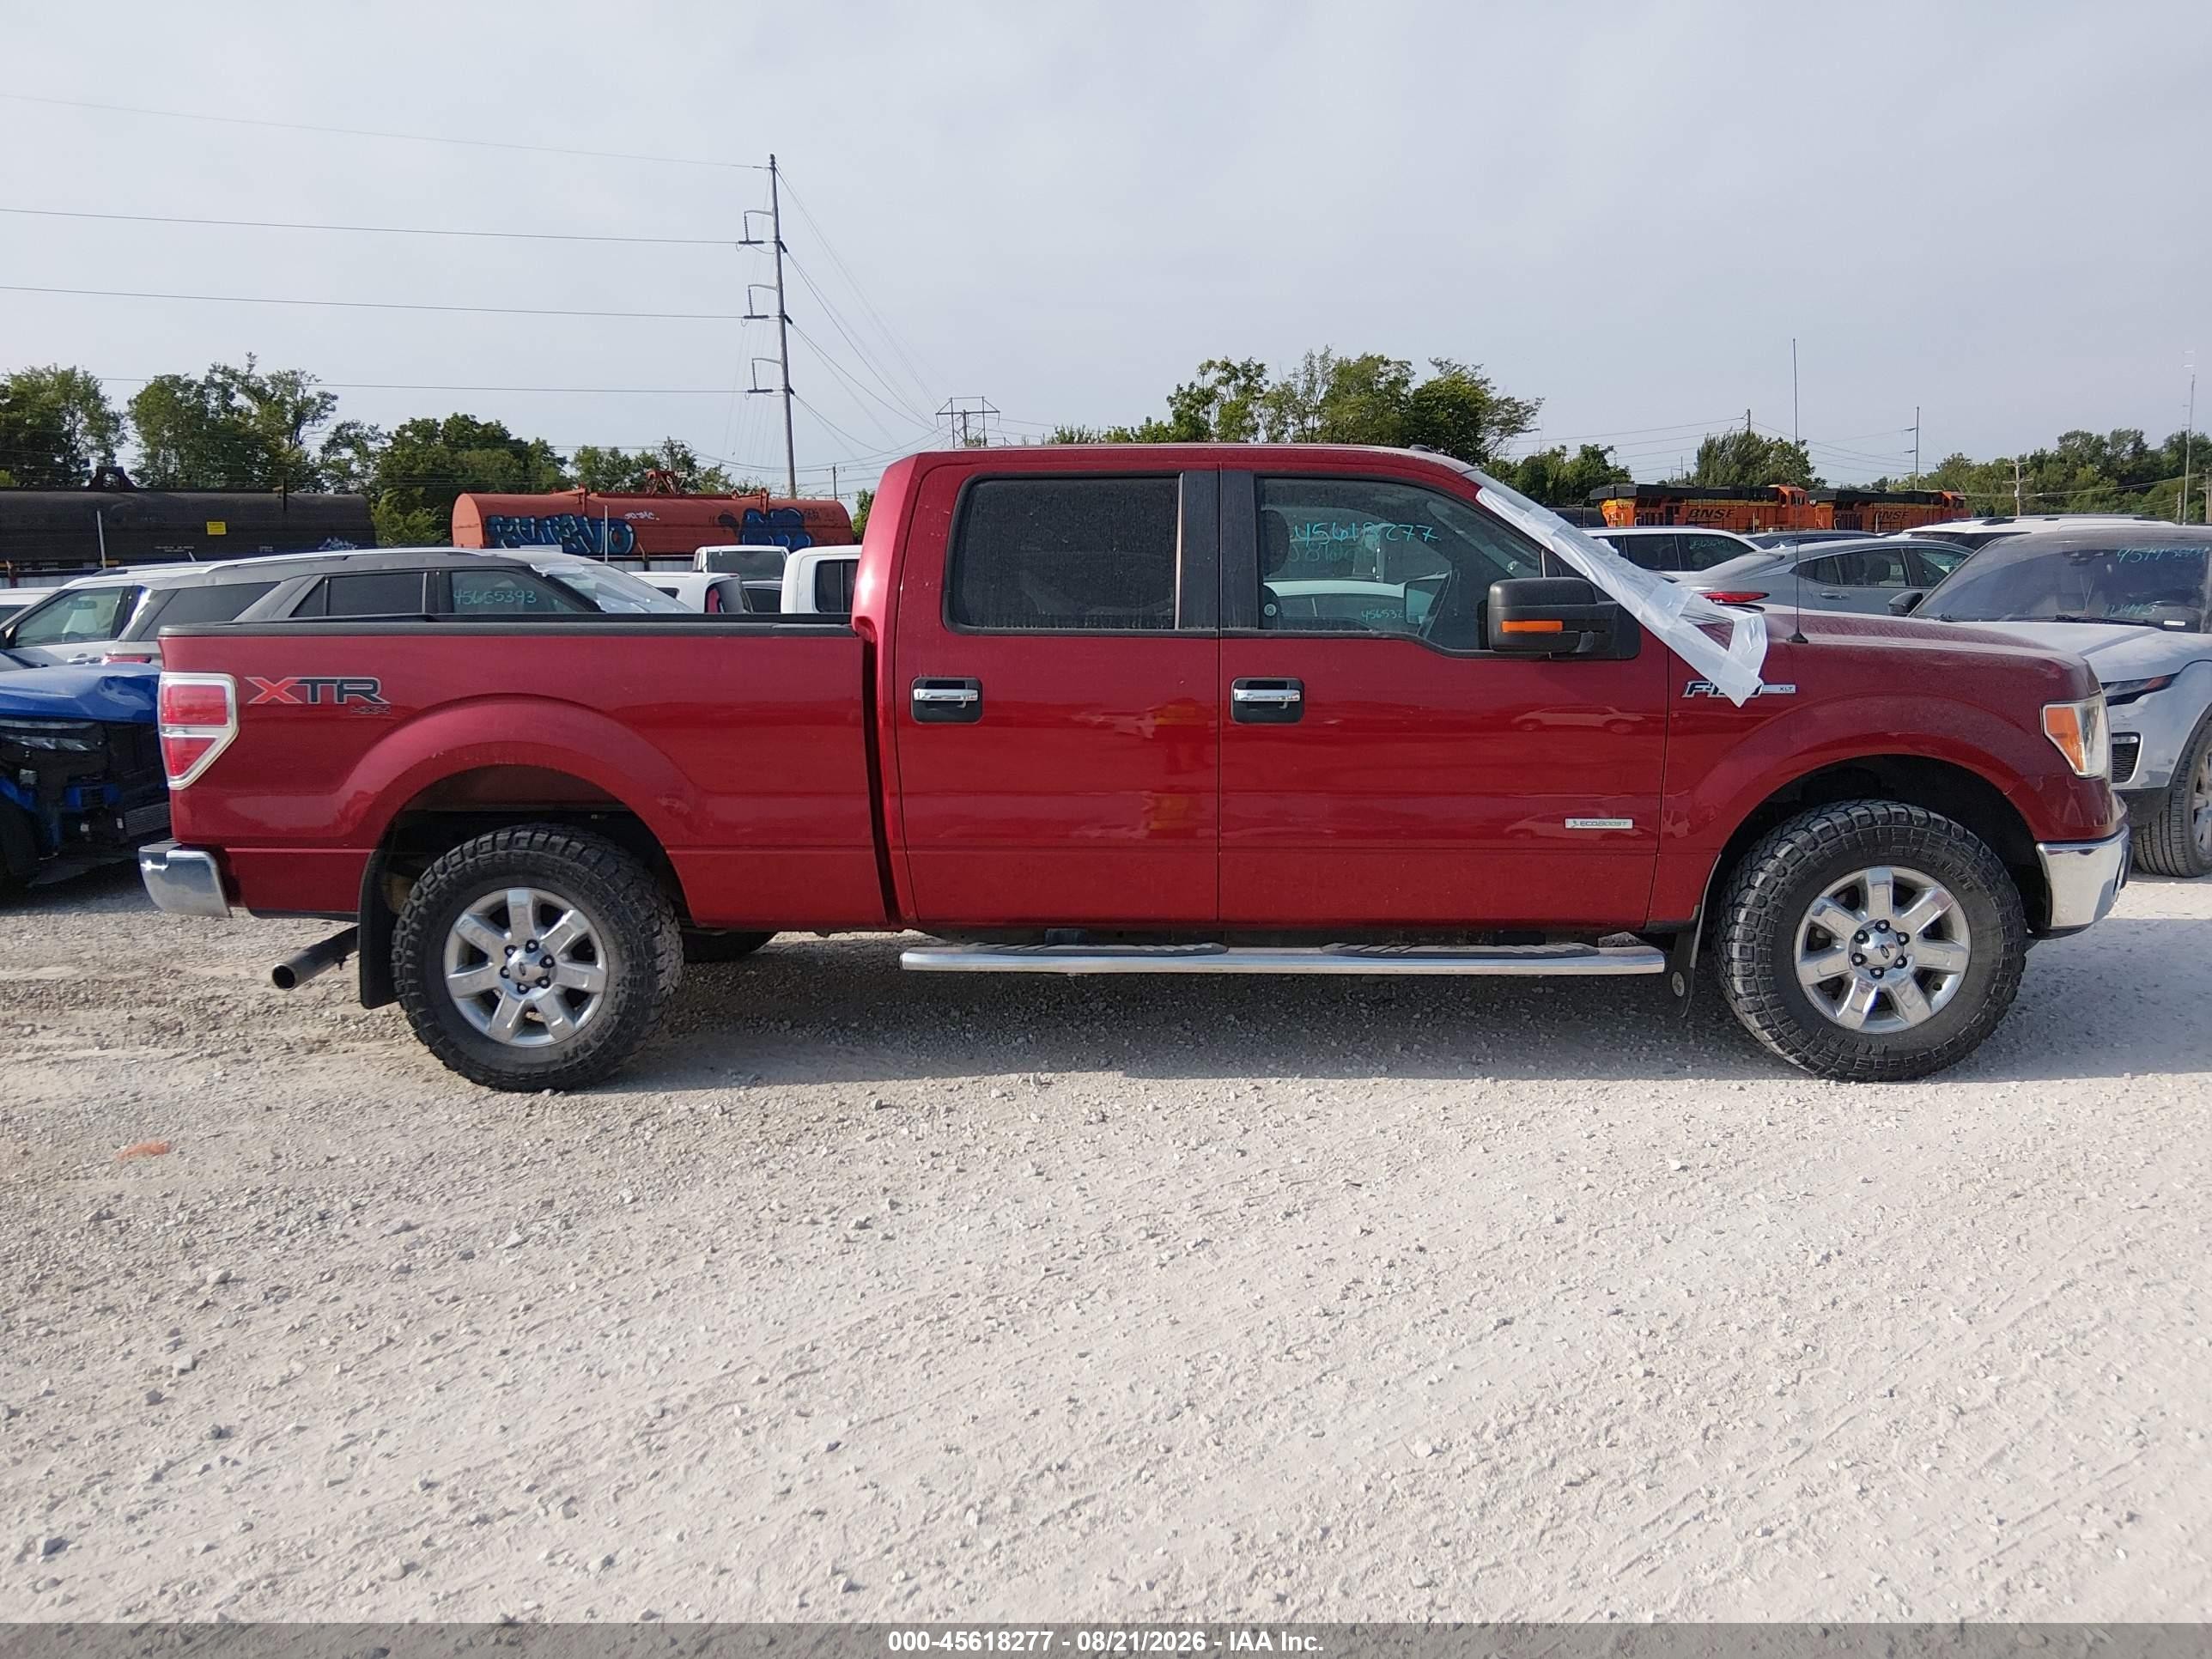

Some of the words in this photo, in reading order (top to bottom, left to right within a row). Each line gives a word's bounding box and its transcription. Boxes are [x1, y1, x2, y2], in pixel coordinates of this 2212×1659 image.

[1688, 508, 1736, 520] BNSF
[1294, 521, 1440, 548] 45618277
[244, 676, 392, 704] XTR
